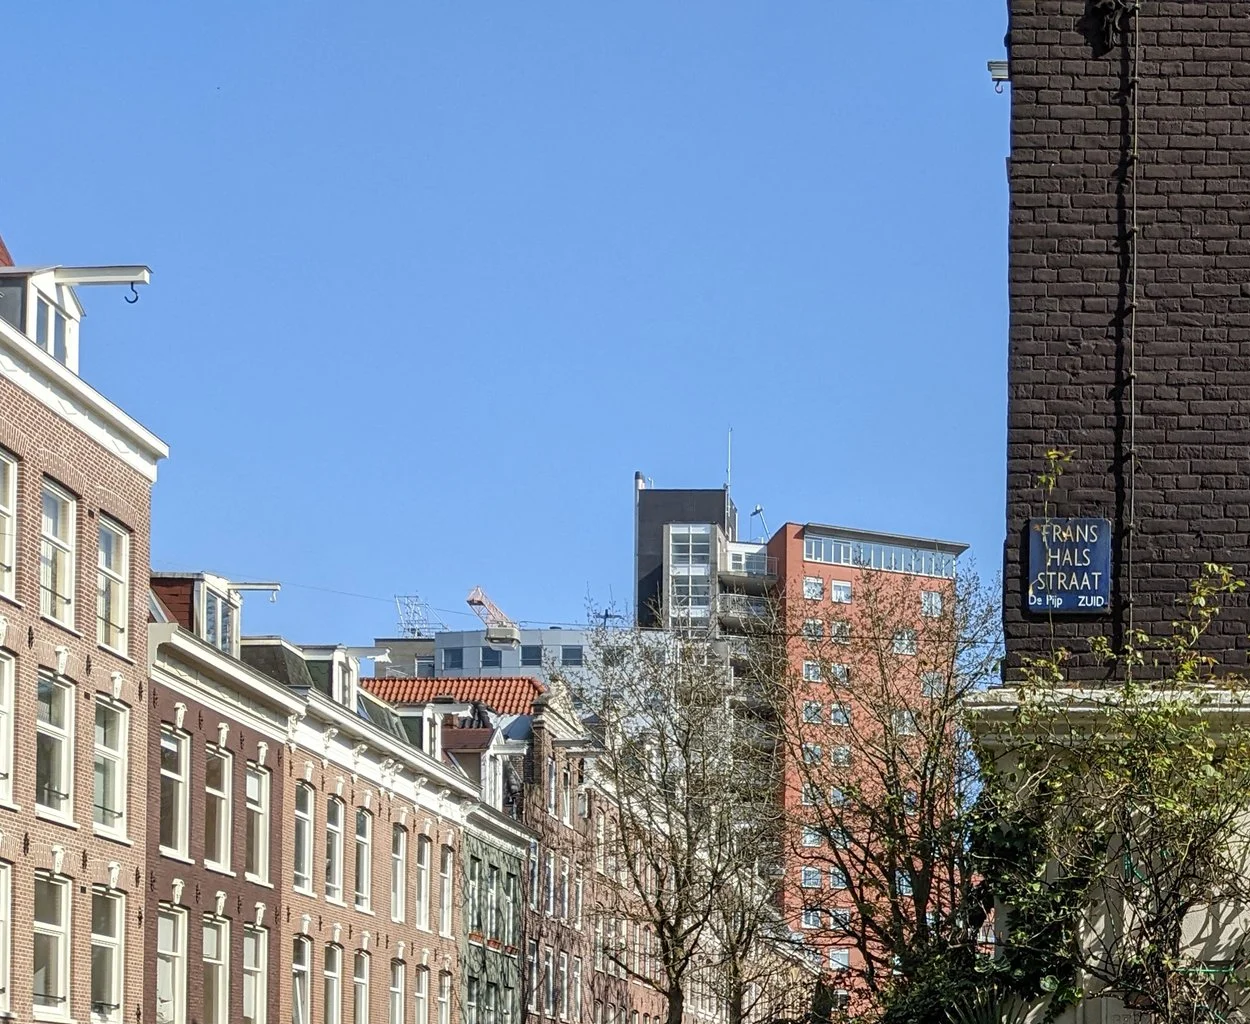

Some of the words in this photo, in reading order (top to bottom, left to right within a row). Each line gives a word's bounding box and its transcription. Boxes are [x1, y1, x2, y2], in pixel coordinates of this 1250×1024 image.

[1041, 524, 1098, 543] FRANS
[1049, 548, 1091, 566] HALS
[1037, 572, 1102, 590] STRAAT
[1028, 594, 1042, 605] De
[1046, 594, 1063, 608] Pijp
[1078, 596, 1105, 607] ZUID
